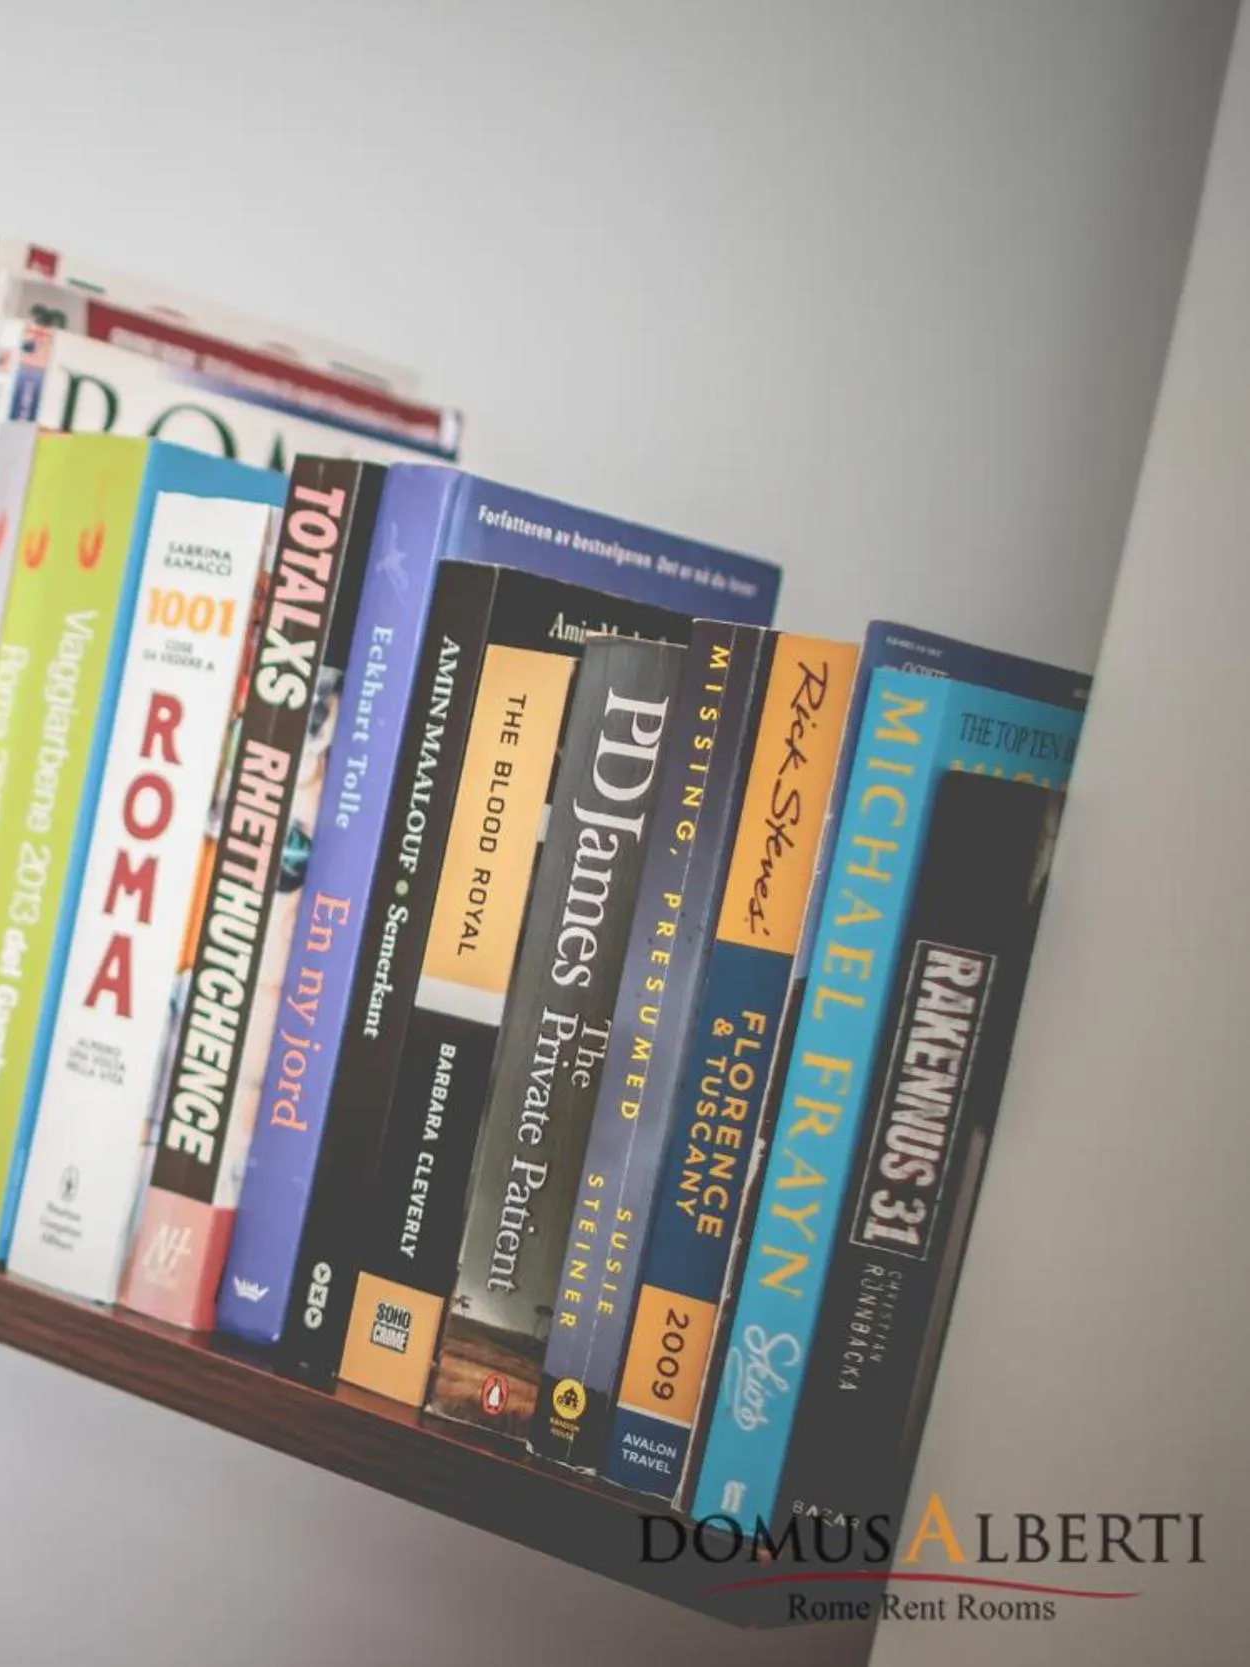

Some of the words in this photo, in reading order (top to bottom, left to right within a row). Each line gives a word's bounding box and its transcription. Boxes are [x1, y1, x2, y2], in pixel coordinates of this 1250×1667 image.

[163, 555, 231, 577] RAMACCI
[167, 541, 232, 562] SABRINA
[478, 504, 552, 540] Forfatteren
[554, 531, 570, 547] av
[147, 587, 236, 638] 1001
[548, 612, 592, 645] Ami
[26, 610, 98, 833] Viaggiarbene
[352, 625, 393, 742] Eckhart
[430, 634, 461, 720] AMIN
[500, 693, 527, 747] THE
[779, 661, 828, 776] Rick
[669, 643, 731, 855] MISSING,
[959, 711, 994, 748] THE
[995, 720, 1029, 755] TOP
[1029, 728, 1060, 761] TEN
[336, 754, 369, 830] Tolle
[398, 722, 445, 876] MAALOUF
[479, 761, 513, 853] BLOOD
[8, 841, 52, 924] 2013
[83, 690, 184, 1020] ROMA
[812, 690, 928, 1021] MICHAEL
[306, 891, 350, 953] En
[457, 869, 492, 957] ROYAL
[286, 968, 324, 1026] ny
[363, 903, 410, 1040] Semerkant
[620, 891, 682, 1120] PRESUMED
[571, 1018, 613, 1088] The
[712, 1019, 735, 1037] &
[879, 949, 983, 1187] RAKENNUS
[270, 1027, 316, 1132] jord
[423, 1042, 456, 1141] BARBARA
[517, 1006, 580, 1145] Private
[675, 1056, 726, 1219] TUSCANY
[697, 1008, 766, 1240] FLORENCE
[400, 1152, 435, 1260] CLEVERLY
[758, 1053, 853, 1298] FRAYN
[863, 1189, 927, 1247] 31
[487, 1157, 548, 1293] Patient
[559, 1173, 605, 1328] STEINER
[597, 1208, 632, 1315] SUSIE
[376, 1302, 411, 1330] SOHO
[652, 1309, 689, 1402] 2009
[621, 1448, 671, 1475] TRAVEL
[622, 1433, 677, 1459] AVALON
